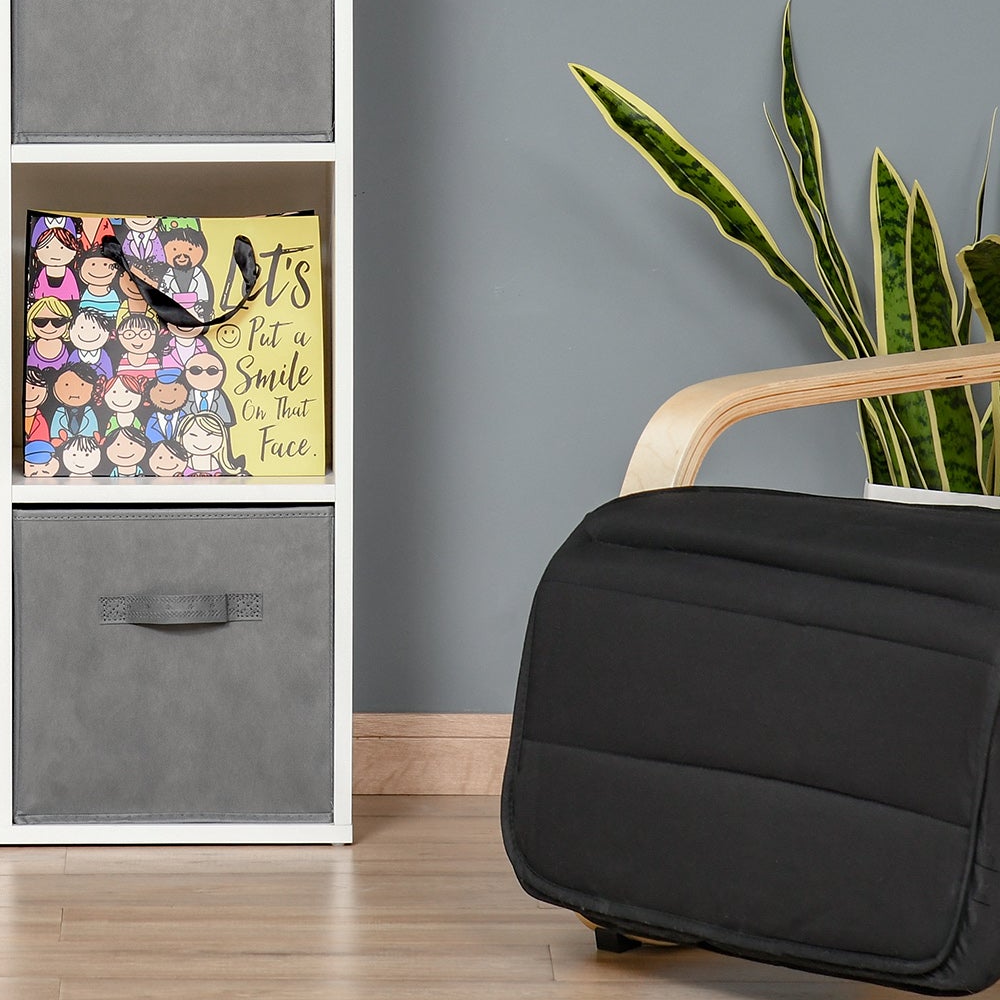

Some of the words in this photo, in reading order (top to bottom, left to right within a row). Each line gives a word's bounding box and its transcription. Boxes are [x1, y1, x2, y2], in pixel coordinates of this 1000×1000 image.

[220, 242, 314, 311] Lt's
[248, 315, 293, 351] Put
[295, 329, 312, 347] a
[234, 351, 312, 395] Smile
[242, 398, 267, 421] On
[273, 396, 317, 420] That
[258, 425, 317, 462] Face.
